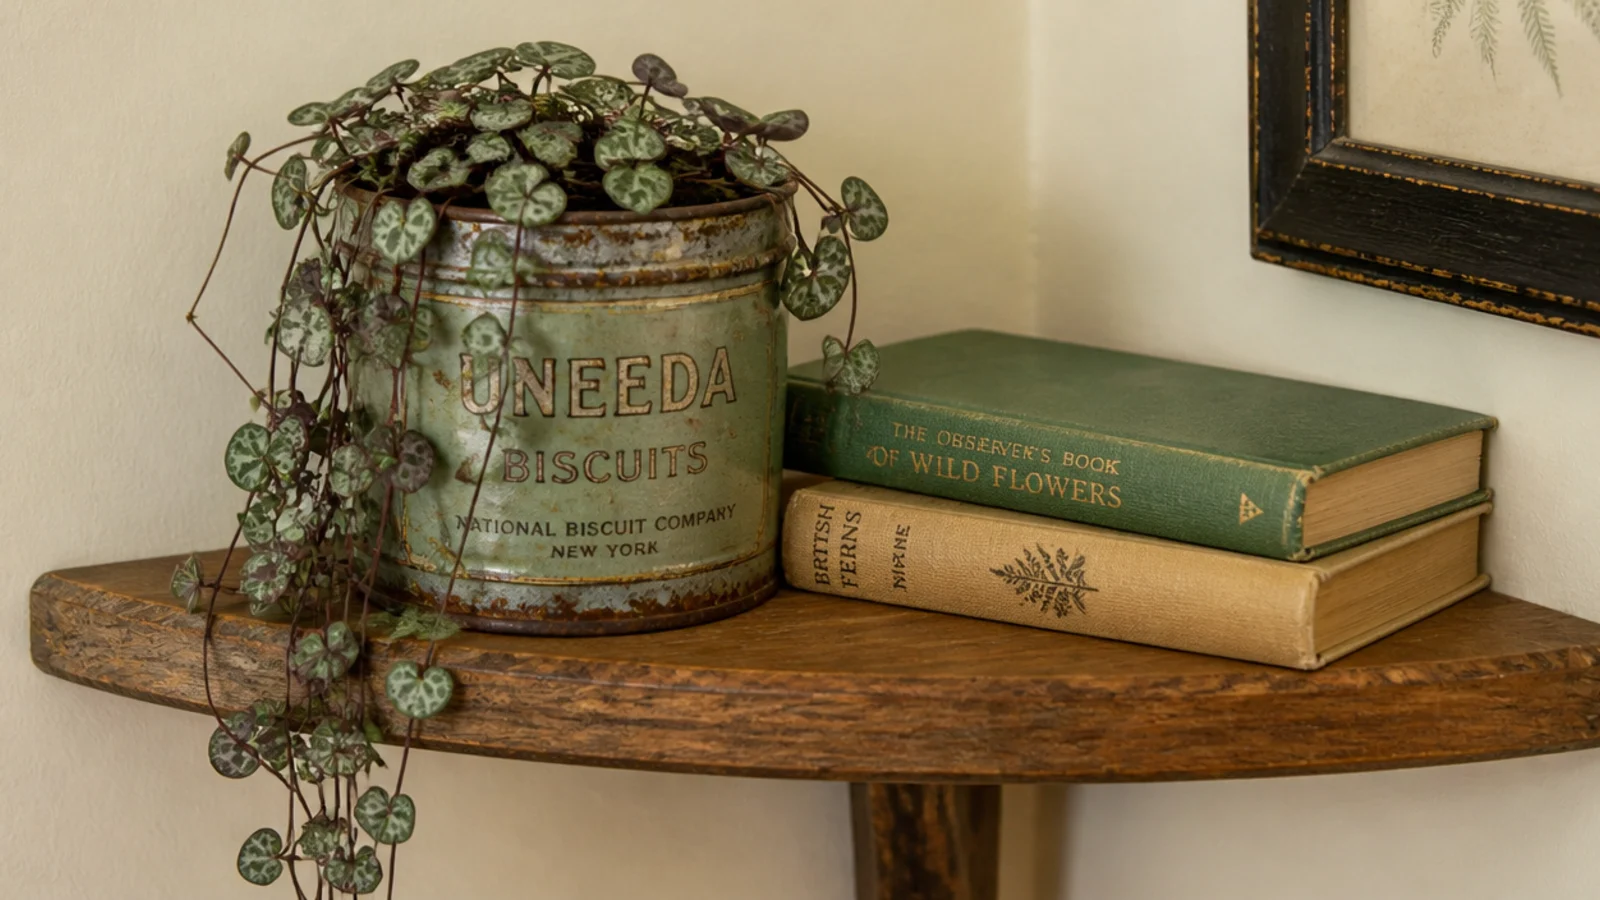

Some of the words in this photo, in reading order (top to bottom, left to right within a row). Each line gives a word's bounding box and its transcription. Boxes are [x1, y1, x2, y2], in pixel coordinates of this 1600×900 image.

[459, 346, 738, 418] UNEEDA
[502, 441, 708, 485] BISCUITS
[892, 422, 928, 442] THE
[1063, 451, 1121, 475] BOOK
[909, 450, 980, 482] WILD
[992, 465, 1122, 509] FLOWERS
[456, 514, 557, 537] NATIONAL
[566, 518, 647, 537] BISCUIT
[654, 503, 737, 532] COMPANY
[551, 545, 598, 559] NEW
[606, 541, 660, 558] YORK
[840, 510, 862, 589] FERNS
